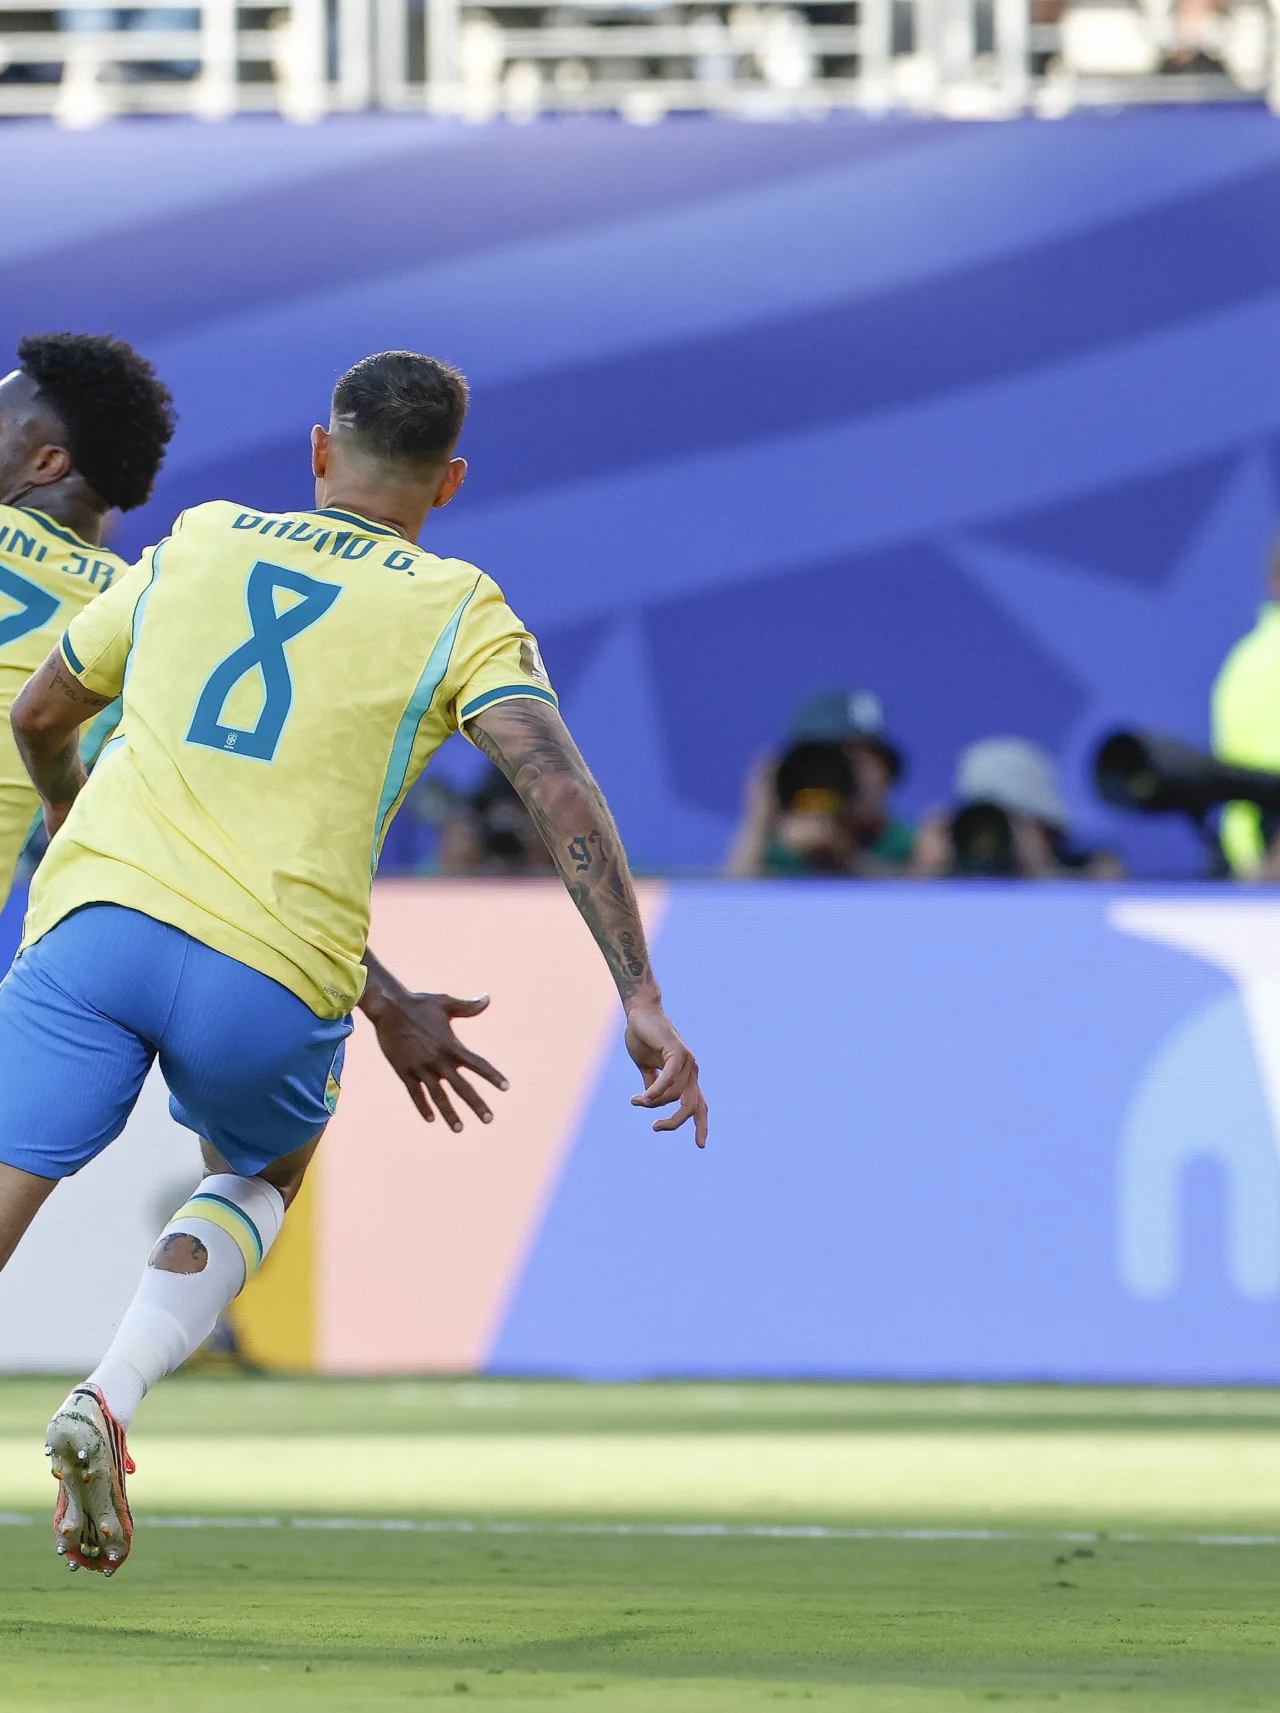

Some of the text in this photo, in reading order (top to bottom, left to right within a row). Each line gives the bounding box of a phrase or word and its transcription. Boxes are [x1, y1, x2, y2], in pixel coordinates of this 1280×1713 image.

[61, 551, 116, 594] JR
[382, 549, 421, 577] G.
[186, 558, 345, 764] 8
